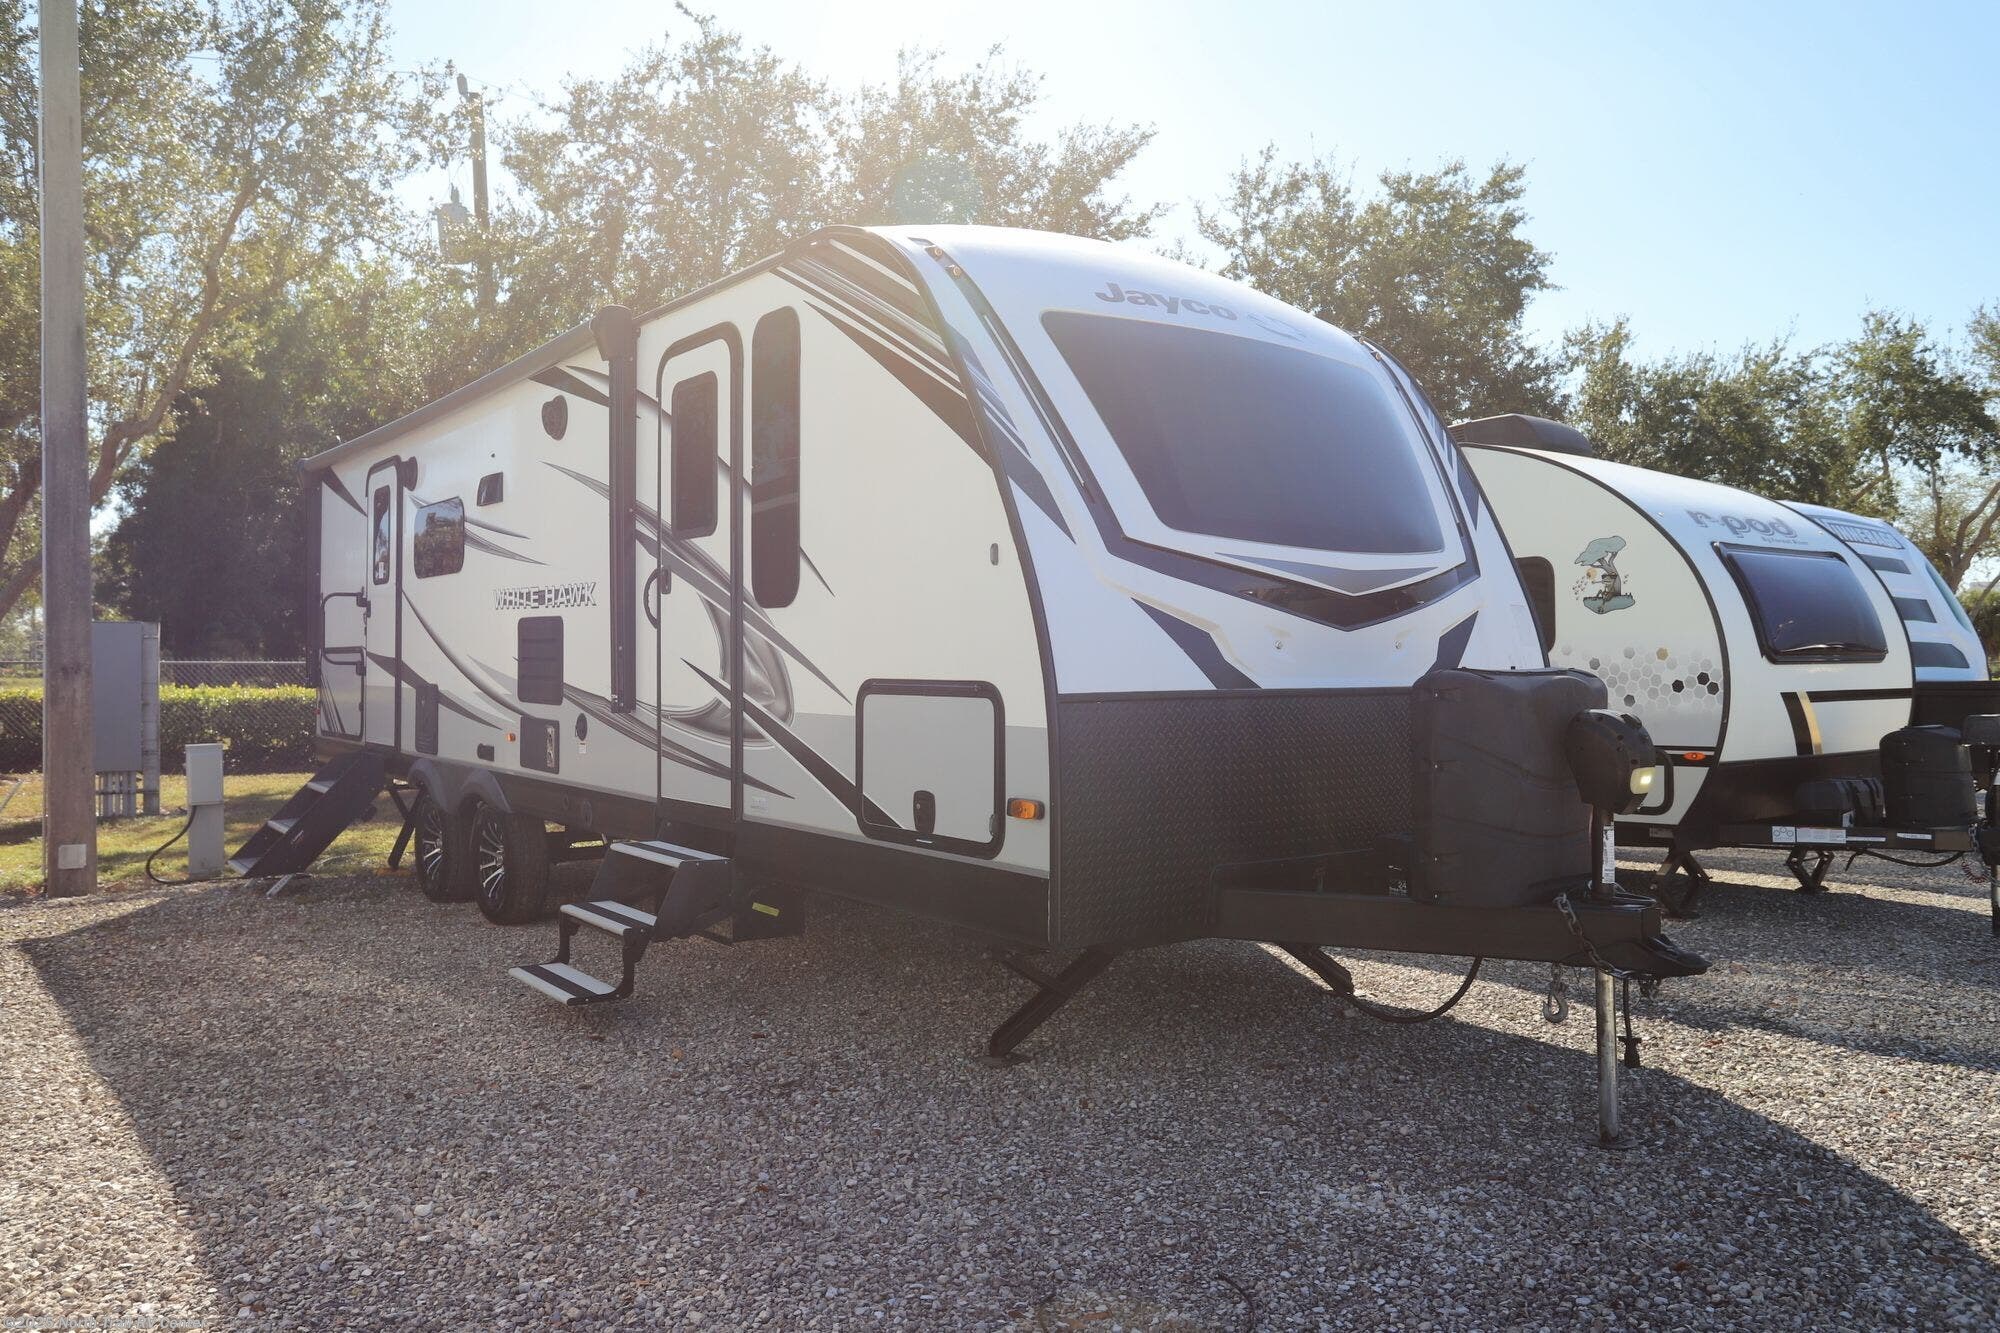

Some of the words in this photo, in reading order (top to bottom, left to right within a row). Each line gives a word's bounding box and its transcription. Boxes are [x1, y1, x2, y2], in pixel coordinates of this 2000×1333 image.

[1095, 282, 1238, 320] Jayco
[493, 586, 540, 610] WHITE
[544, 582, 597, 608] HAWK
